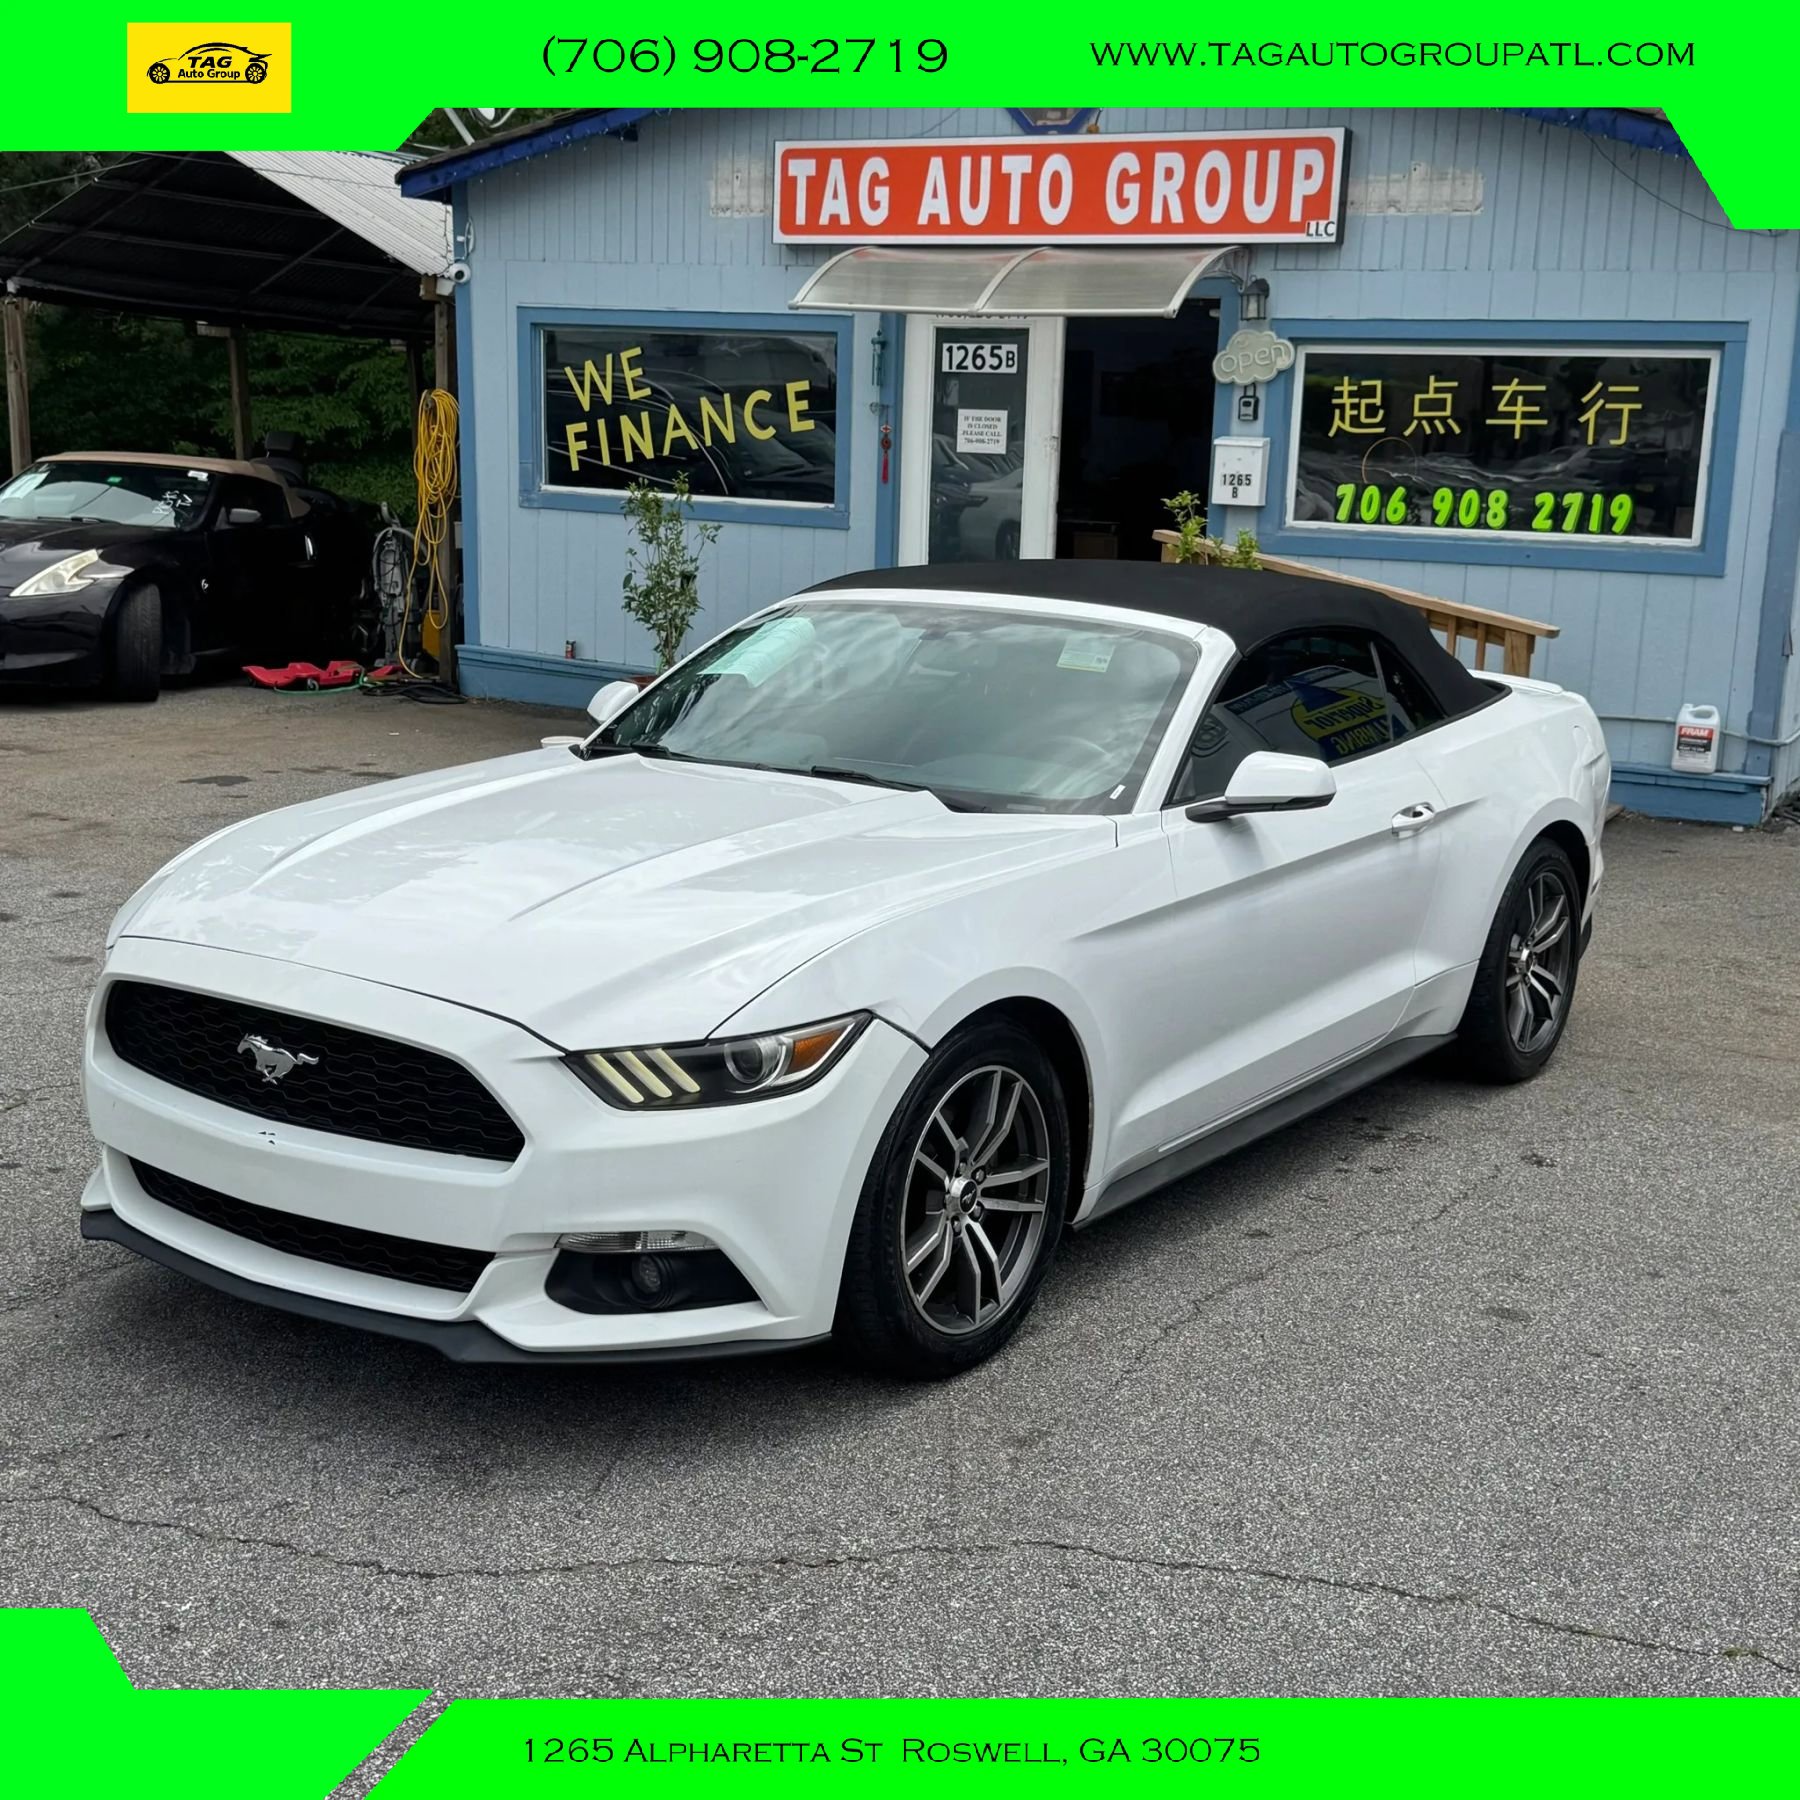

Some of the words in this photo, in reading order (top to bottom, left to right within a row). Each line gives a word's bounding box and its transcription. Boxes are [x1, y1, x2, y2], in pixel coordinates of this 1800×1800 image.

[787, 156, 890, 227] TAG
[917, 153, 1073, 226] AUTO
[1106, 148, 1326, 226] GROUP
[1306, 220, 1335, 238] LLC
[564, 346, 651, 412] WE
[1220, 344, 1286, 374] open
[566, 380, 815, 471] FINANCE
[1327, 375, 1643, 446] 起点车行
[1222, 473, 1252, 486] 1265
[1231, 487, 1239, 499] B
[1335, 483, 1408, 525] 706
[1432, 487, 1508, 530] 908
[1532, 492, 1633, 535] 2719
[1680, 727, 1710, 737] FRAM
